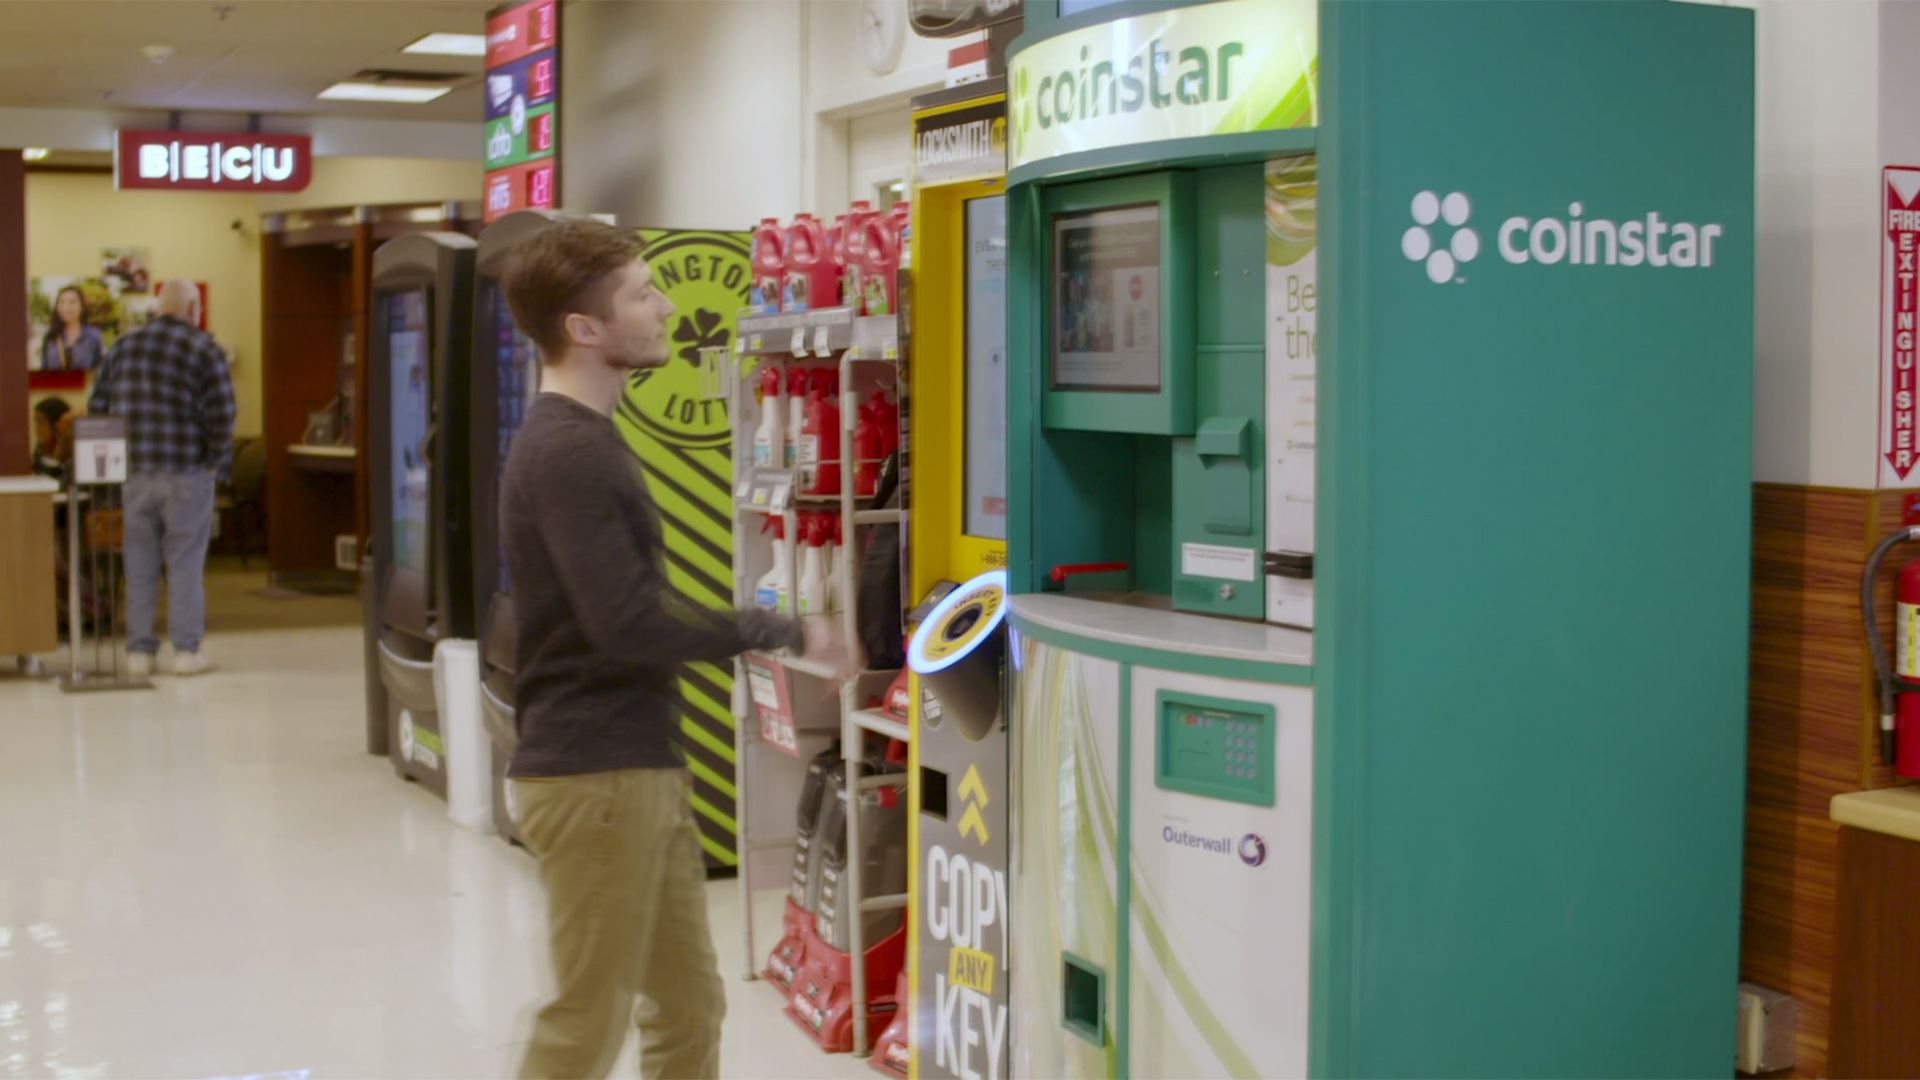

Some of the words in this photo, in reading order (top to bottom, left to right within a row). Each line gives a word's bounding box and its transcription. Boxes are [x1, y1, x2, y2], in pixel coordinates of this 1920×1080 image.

[1037, 38, 1243, 130] coinstar
[916, 119, 990, 167] LOCKSMITH
[1498, 202, 1722, 267] coinstar
[1889, 210, 1920, 231] FIRE
[1286, 317, 1319, 359] th
[1895, 232, 1914, 468] EXTINGUISHER
[1162, 825, 1231, 855] Outerwall
[927, 845, 1007, 971] COPY
[955, 952, 988, 988] ANY
[935, 972, 1007, 1080] KEY
